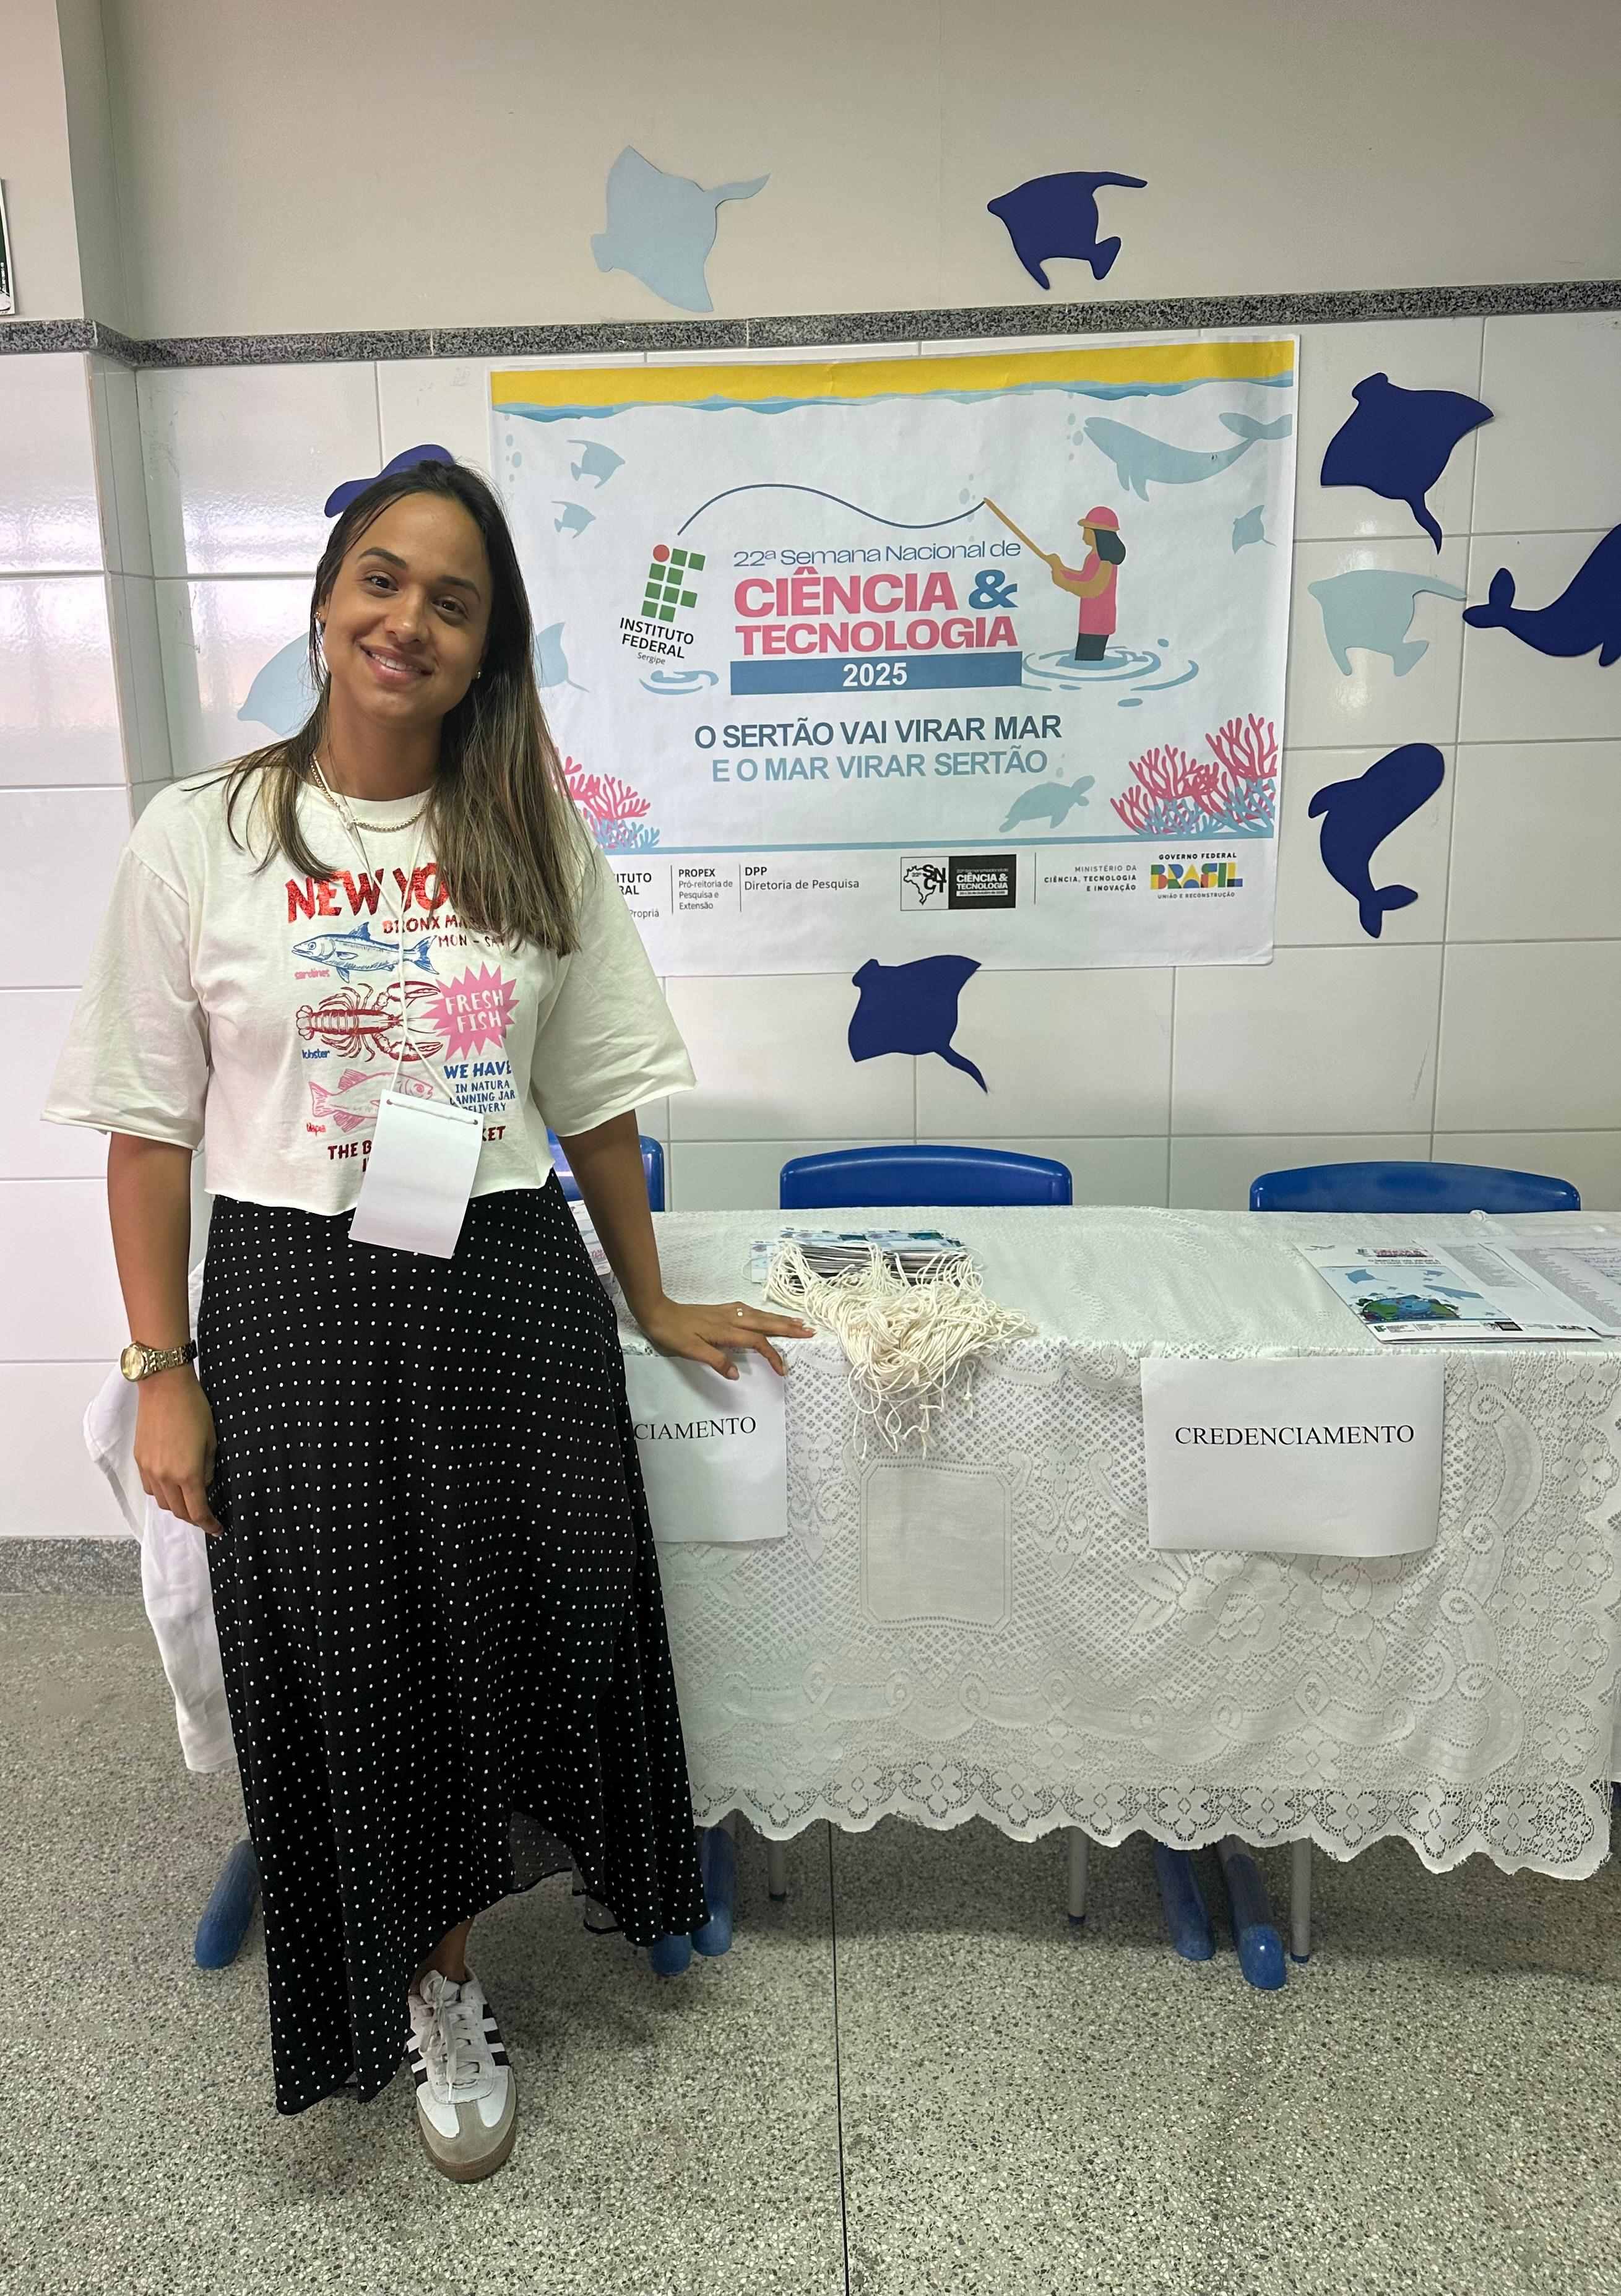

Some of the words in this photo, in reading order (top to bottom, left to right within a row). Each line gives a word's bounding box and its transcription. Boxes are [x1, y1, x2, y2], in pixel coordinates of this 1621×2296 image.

[780, 548, 881, 565] Semana
[886, 542, 985, 562] Nacional
[990, 540, 1021, 557] de
[734, 566, 959, 618] CIÊNCIA
[969, 569, 1019, 610] &
[620, 617, 694, 645] INSTITUTO
[735, 616, 1018, 655] TECNOLOGIA
[621, 633, 685, 659] FEDERAL
[637, 652, 666, 665] Sergipe
[842, 663, 908, 687] 2025
[694, 725, 717, 749] O
[722, 717, 834, 748] SERTÃO
[839, 721, 887, 744] VAI
[894, 717, 986, 743] VIRAR
[995, 715, 1062, 740] MAR
[712, 759, 730, 782] E
[737, 758, 758, 782] O
[765, 756, 829, 781] MAR
[836, 753, 927, 779] VIRAR
[934, 744, 1048, 777] SERTÃO
[615, 873, 652, 883] ITUTO
[678, 868, 715, 878] PROPEX
[745, 866, 767, 876] DPP
[956, 872, 997, 883] CIÊNCIA
[998, 873, 1008, 882] &
[1084, 874, 1136, 882] TECNOLOGIA
[1150, 862, 1243, 889] BRASIL
[285, 868, 384, 923] NEW
[392, 863, 451, 913] YO
[679, 879, 722, 889] Pró-reitoria
[745, 879, 792, 891] Diretoria
[795, 879, 809, 890] de
[812, 878, 860, 891] Pesquisa
[956, 883, 1008, 891] TECNOLOGIA
[1094, 883, 1136, 892] INOVAÇÃO
[679, 891, 713, 900] Pesquisa
[679, 902, 714, 910] Extensão
[438, 933, 468, 948] MON
[445, 989, 504, 1016] FRESH
[457, 1009, 502, 1034] FISH
[443, 1064, 469, 1079] WE
[472, 1060, 512, 1077] HAVE
[455, 1084, 468, 1094] IN
[471, 1080, 510, 1092] NATURA
[498, 1090, 516, 1100] JAR
[327, 1141, 358, 1160] THE
[634, 1416, 756, 1440] CIAMENTO
[1175, 1424, 1415, 1446] CREDENCIAMENTO
